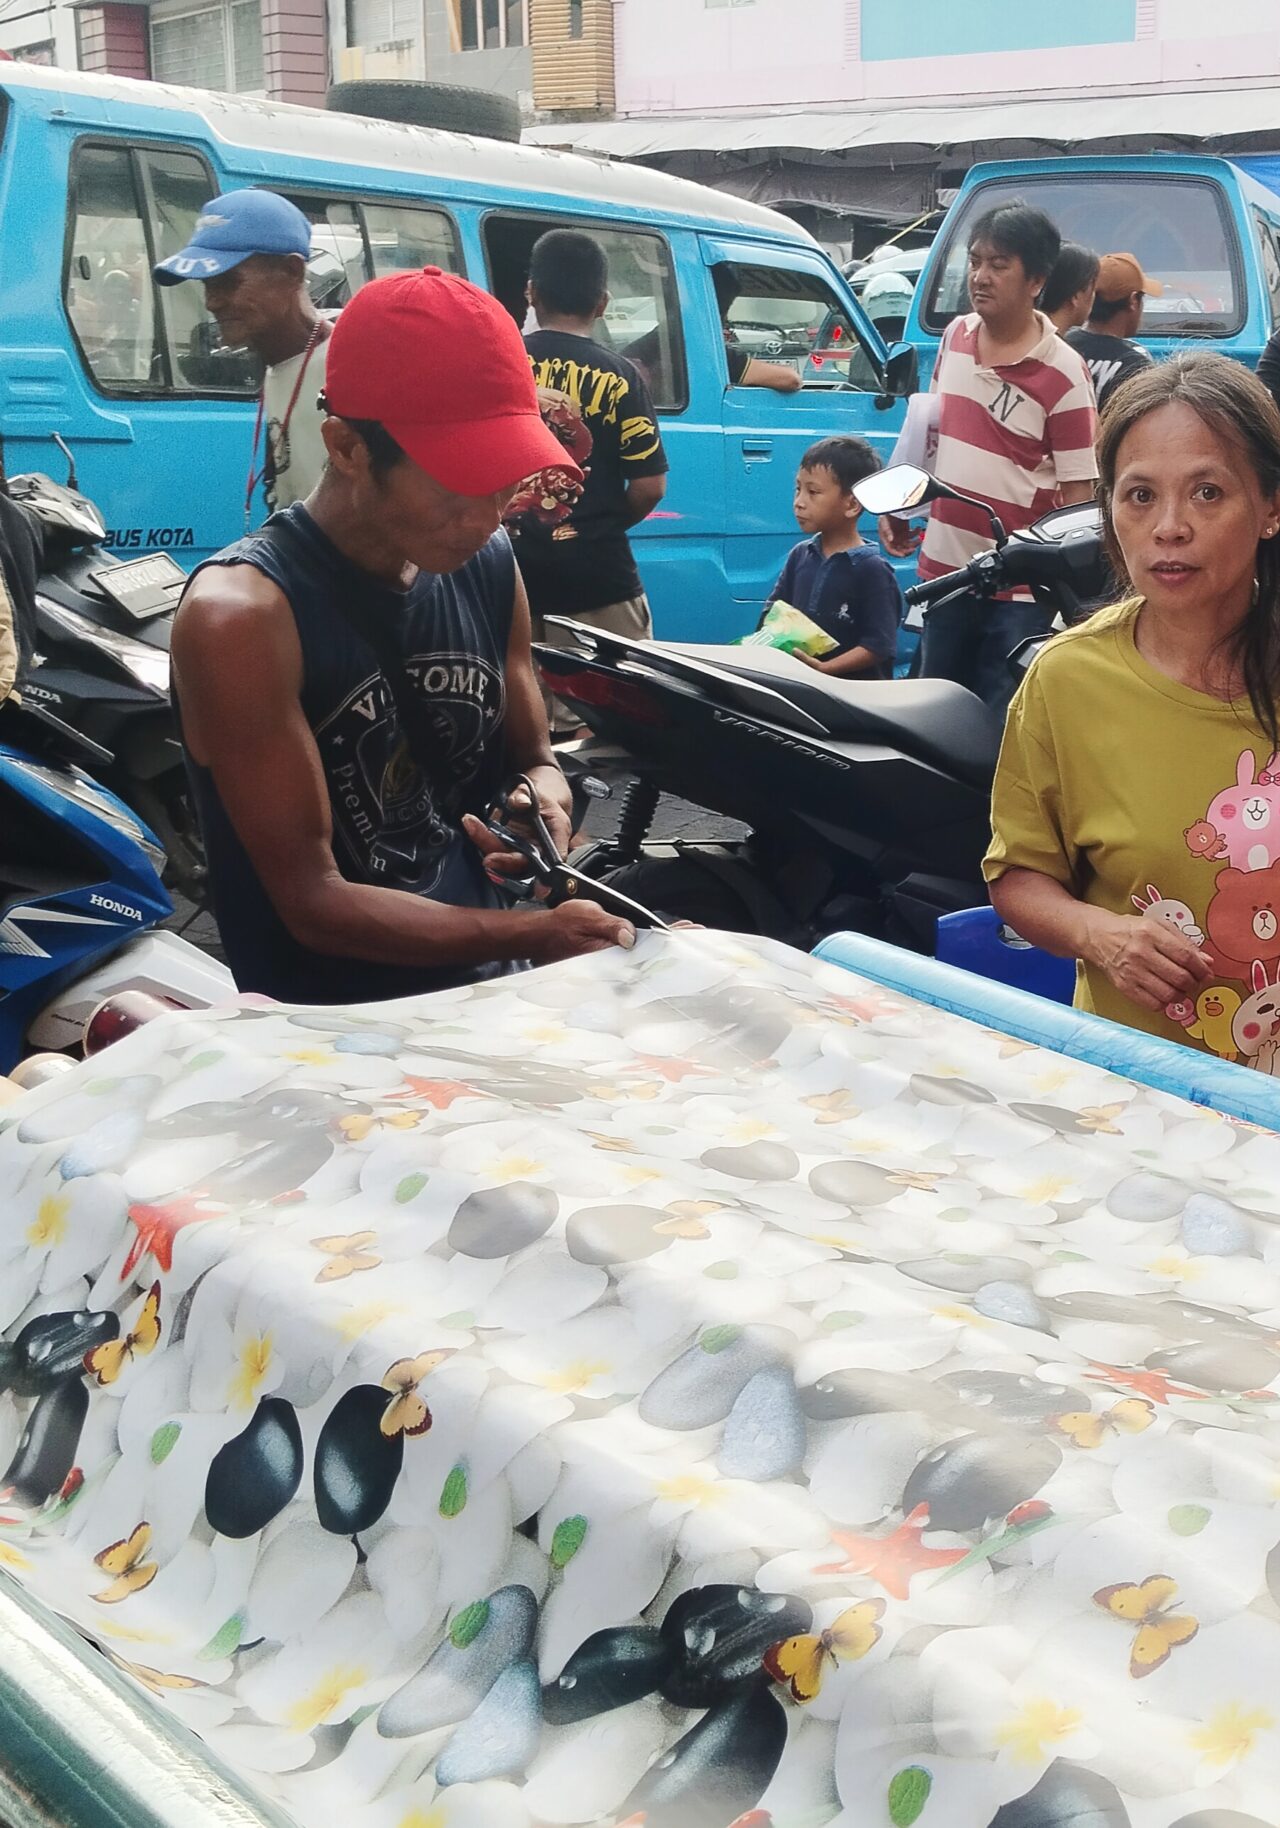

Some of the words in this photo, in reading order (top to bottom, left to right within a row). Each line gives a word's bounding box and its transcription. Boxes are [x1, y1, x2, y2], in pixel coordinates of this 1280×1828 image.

[988, 382, 1025, 422] N
[101, 528, 144, 548] BUS
[145, 527, 195, 547] KOTA
[88, 893, 143, 922] HONDA
